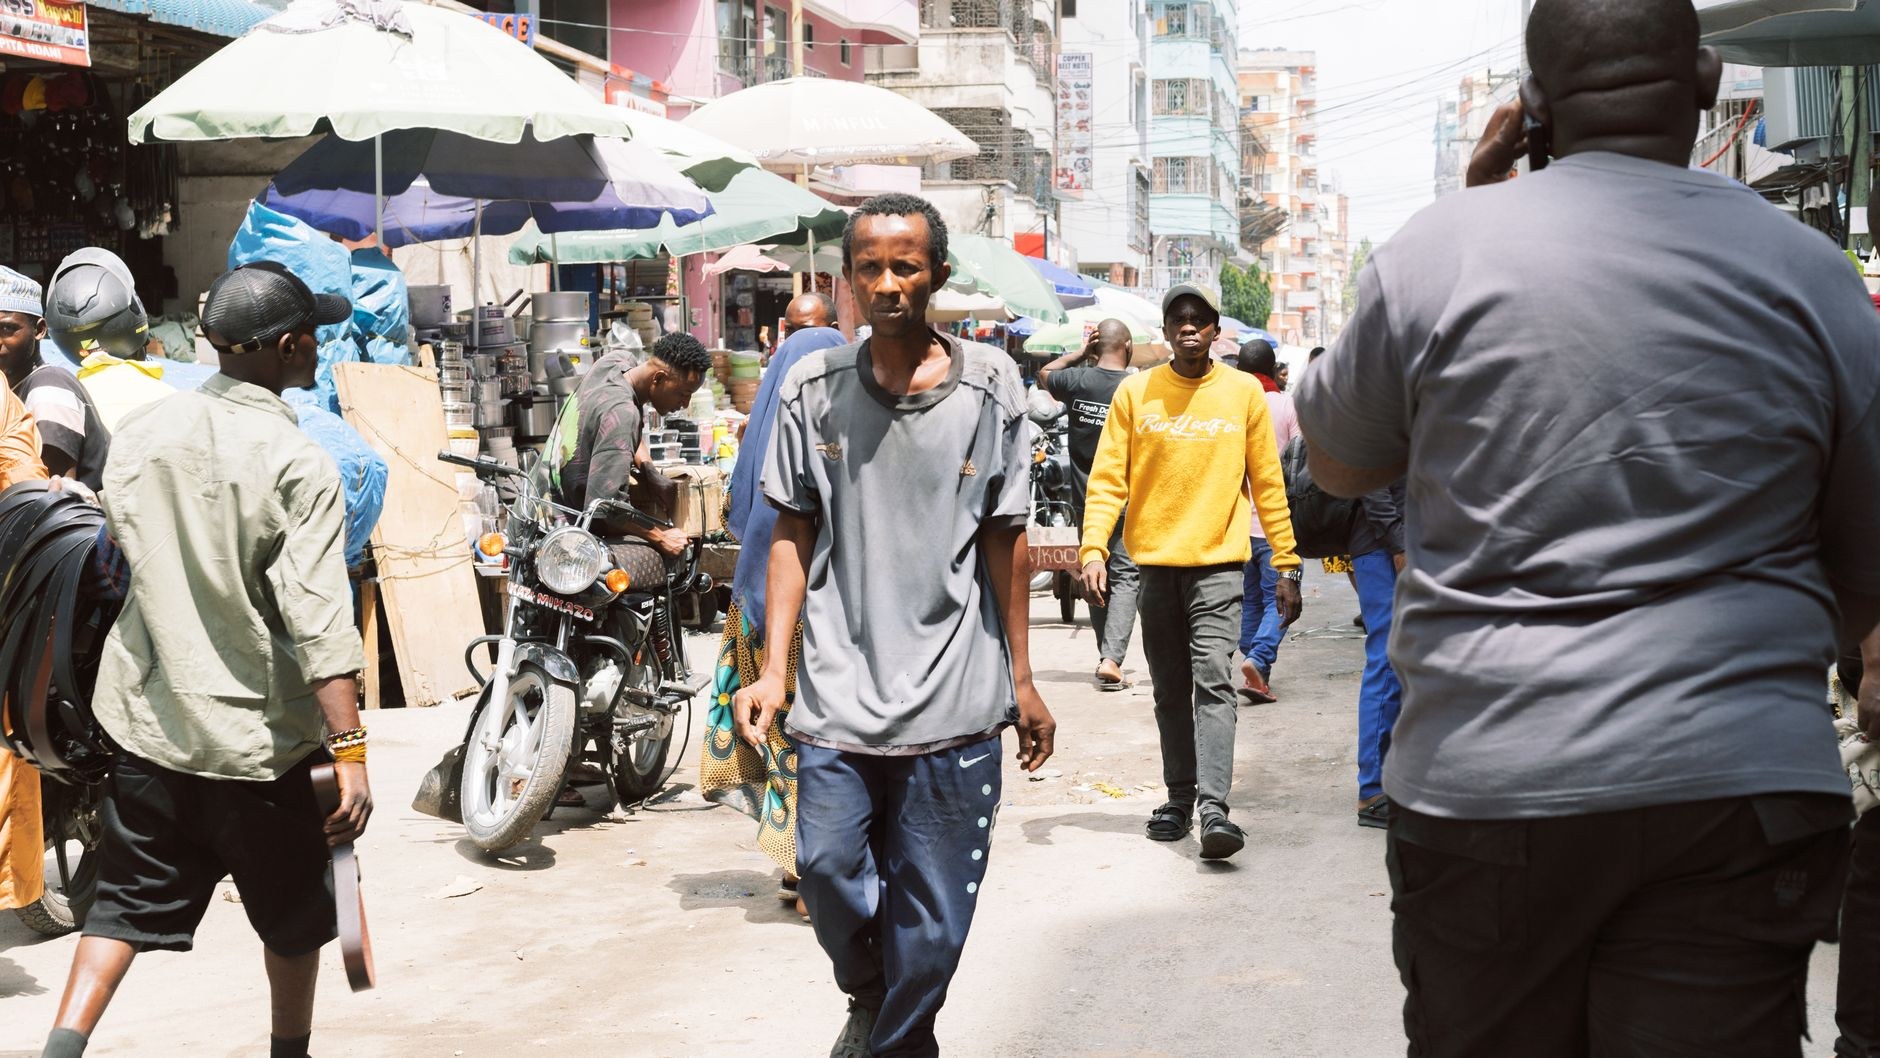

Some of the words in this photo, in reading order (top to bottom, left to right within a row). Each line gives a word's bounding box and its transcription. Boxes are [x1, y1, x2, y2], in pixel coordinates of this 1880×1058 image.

[1079, 403, 1098, 413] Fresh
[1079, 416, 1095, 425] Good
[536, 592, 594, 622] MIKAZO
